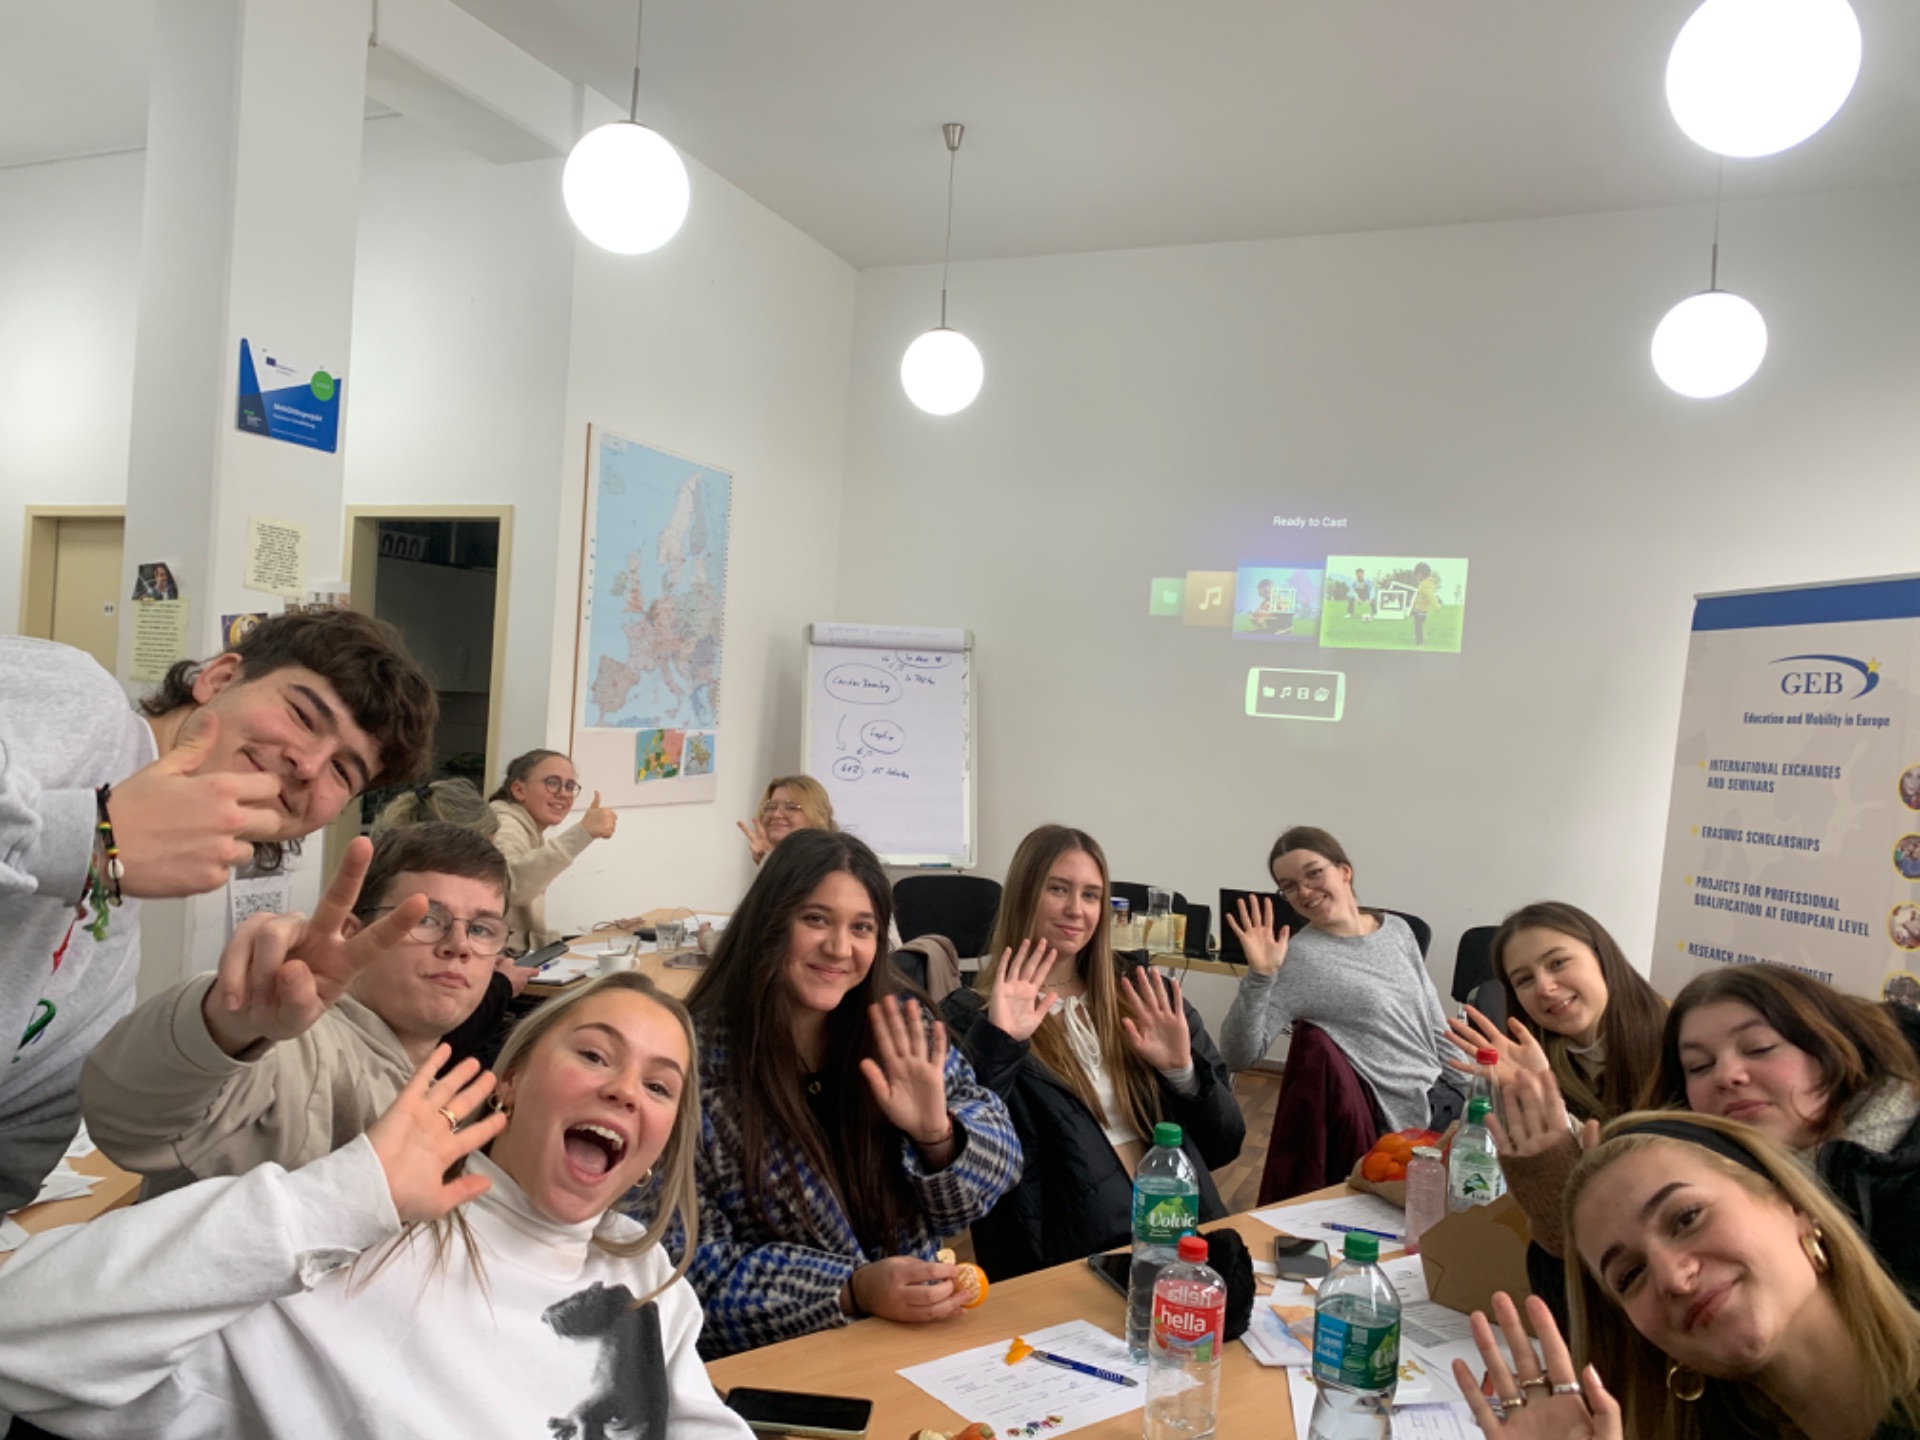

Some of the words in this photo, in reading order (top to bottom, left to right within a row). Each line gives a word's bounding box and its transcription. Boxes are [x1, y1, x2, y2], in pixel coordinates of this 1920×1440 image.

[1273, 515, 1305, 529] Ready
[1309, 517, 1319, 527] to
[1322, 516, 1347, 528] Cast
[1780, 672, 1843, 695] GEB
[1743, 712, 1784, 725] Education
[1786, 713, 1802, 725] and
[1805, 713, 1841, 727] Mobility
[1844, 713, 1854, 726] in
[1856, 714, 1890, 729] Europe
[1708, 759, 1777, 776] INTERNATIONAL
[1782, 763, 1841, 779] EXCHANGES
[1707, 777, 1725, 790] AND
[1728, 778, 1775, 793] SEMINARS
[1702, 826, 1743, 842] ERASMUS
[1746, 830, 1820, 852] SCHOLARSHIPS
[1696, 876, 1740, 894] PROJECTS
[1743, 883, 1761, 898] FOR
[1765, 887, 1841, 911] PROFESSIONAL
[1694, 893, 1762, 917] QUALIFICATION
[1765, 906, 1777, 920] AT
[1780, 909, 1835, 930] EUROPEAN
[1838, 919, 1870, 937] LEVEL
[1688, 942, 1733, 964] RESEARCH
[1149, 1211, 1195, 1228] Volvic
[1161, 1304, 1207, 1333] hella
